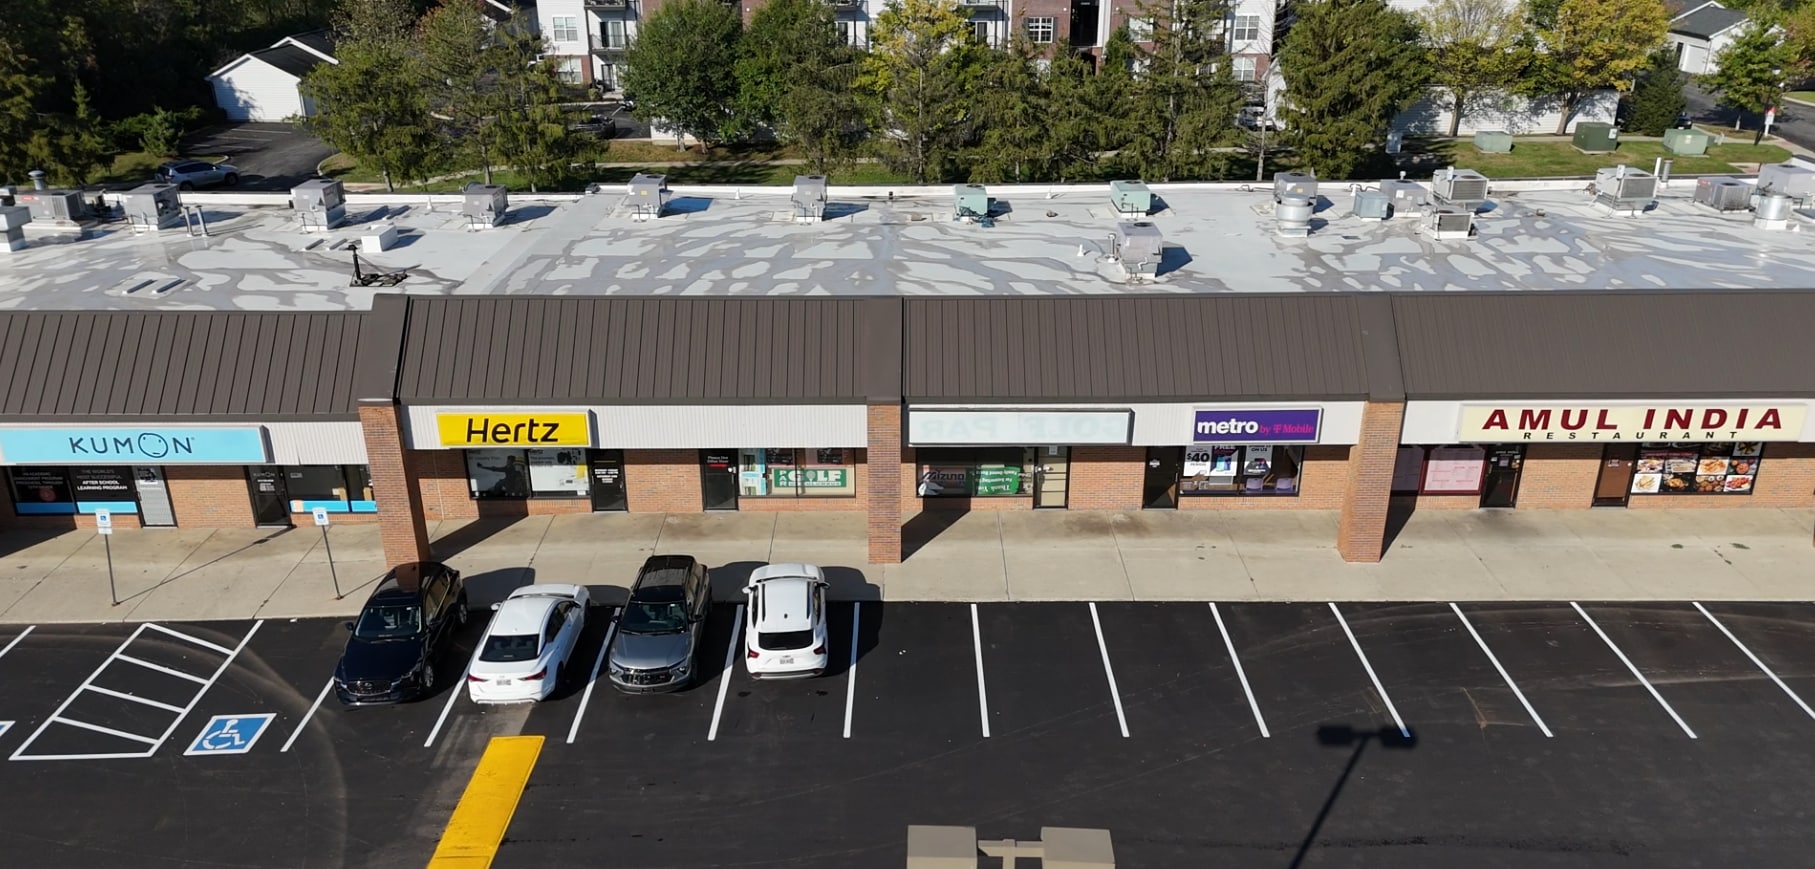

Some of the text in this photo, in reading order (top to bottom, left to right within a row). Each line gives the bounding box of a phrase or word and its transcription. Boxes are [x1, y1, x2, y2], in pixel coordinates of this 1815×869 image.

[1197, 418, 1259, 434] metro
[1259, 425, 1271, 435] by
[1482, 407, 1783, 430] AMUL INDIA
[466, 418, 560, 443] Hertz
[1523, 430, 1739, 441] RESTAURANT
[69, 432, 193, 458] KUMON
[1187, 452, 1210, 462] $40
